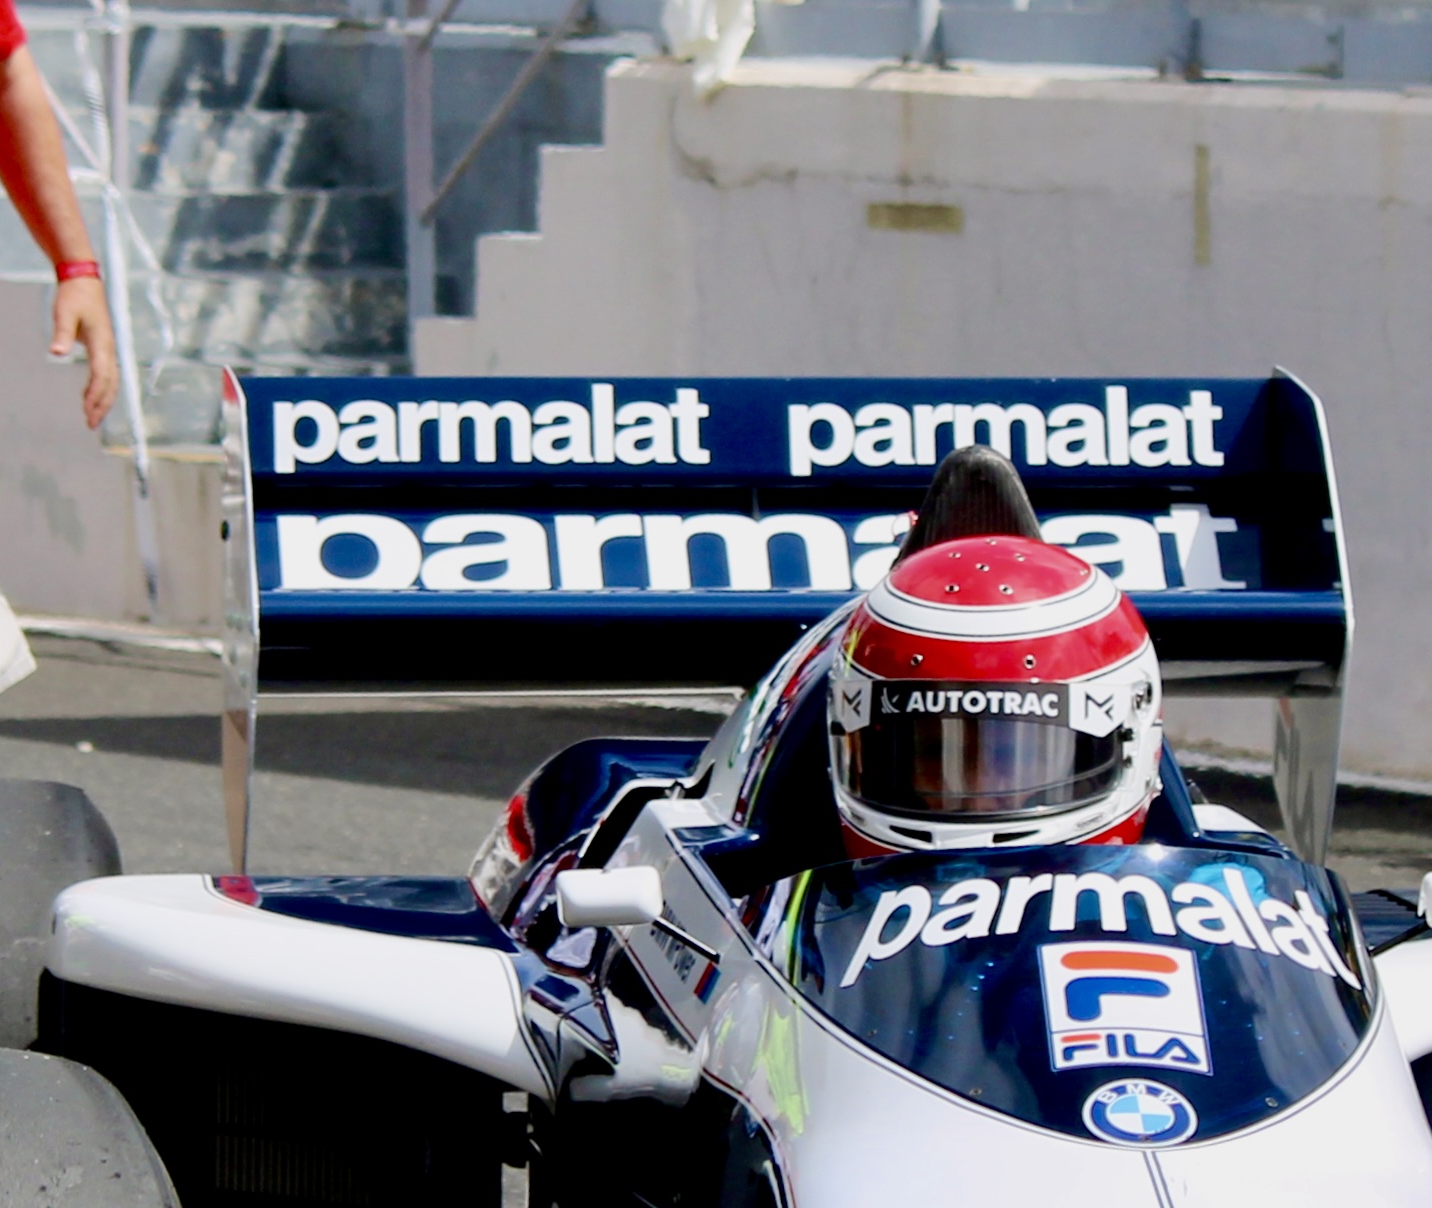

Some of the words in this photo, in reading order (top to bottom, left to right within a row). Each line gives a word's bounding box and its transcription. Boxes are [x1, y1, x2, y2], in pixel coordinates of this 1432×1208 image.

[273, 383, 711, 475] parmalat
[788, 385, 1225, 477] parmalat
[273, 503, 1248, 594] parmat
[905, 690, 1060, 718] AUTOTRAC
[839, 867, 1363, 991] parmalat
[1060, 1033, 1201, 1066] FILA
[1097, 1083, 1181, 1106] BMW
